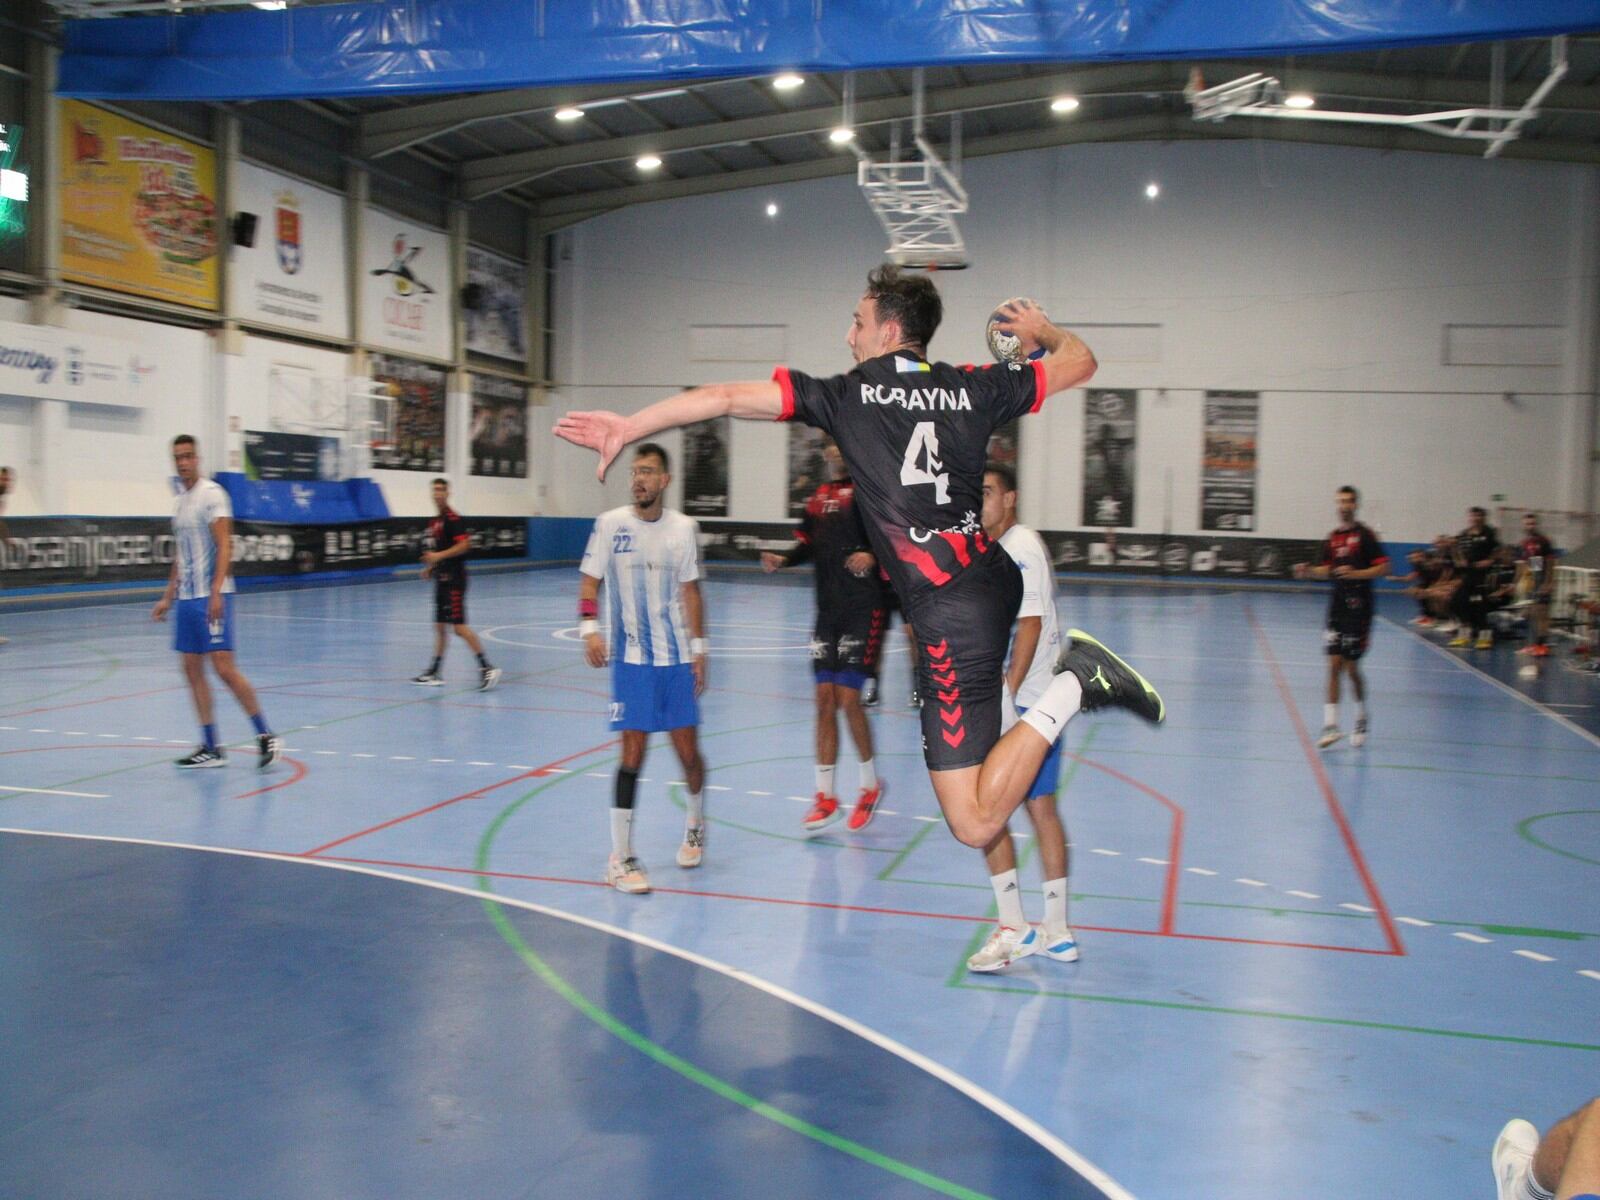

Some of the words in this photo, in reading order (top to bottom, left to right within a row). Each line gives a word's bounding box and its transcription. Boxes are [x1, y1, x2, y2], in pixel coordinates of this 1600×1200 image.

[860, 383, 972, 412] ROBAYNA
[899, 421, 952, 506] 4
[612, 534, 633, 554] 22
